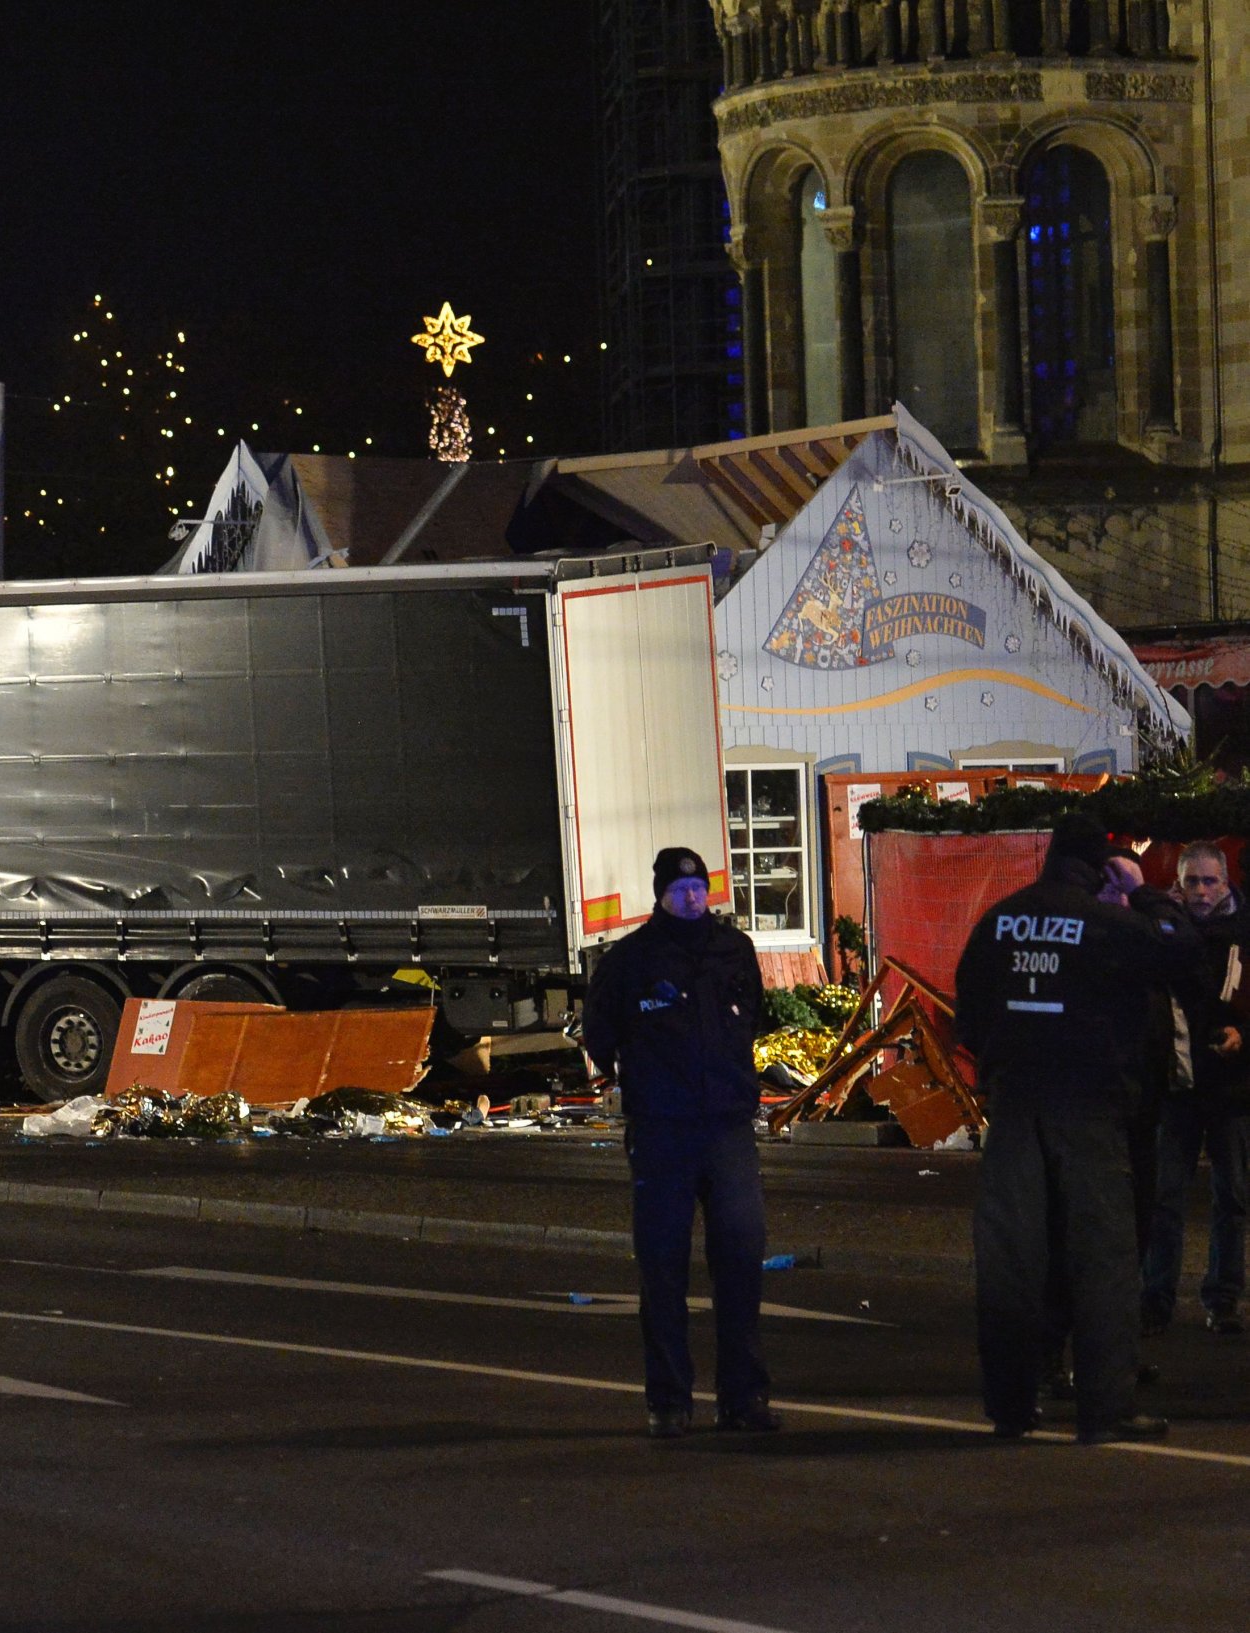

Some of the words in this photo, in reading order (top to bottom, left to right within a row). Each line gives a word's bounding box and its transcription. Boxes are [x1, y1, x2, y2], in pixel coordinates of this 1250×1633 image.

[865, 594, 968, 631] FASZINATION
[869, 615, 985, 650] WEIHNACHTEN
[995, 914, 1085, 945] POLIZEI
[1012, 950, 1060, 974] 32000
